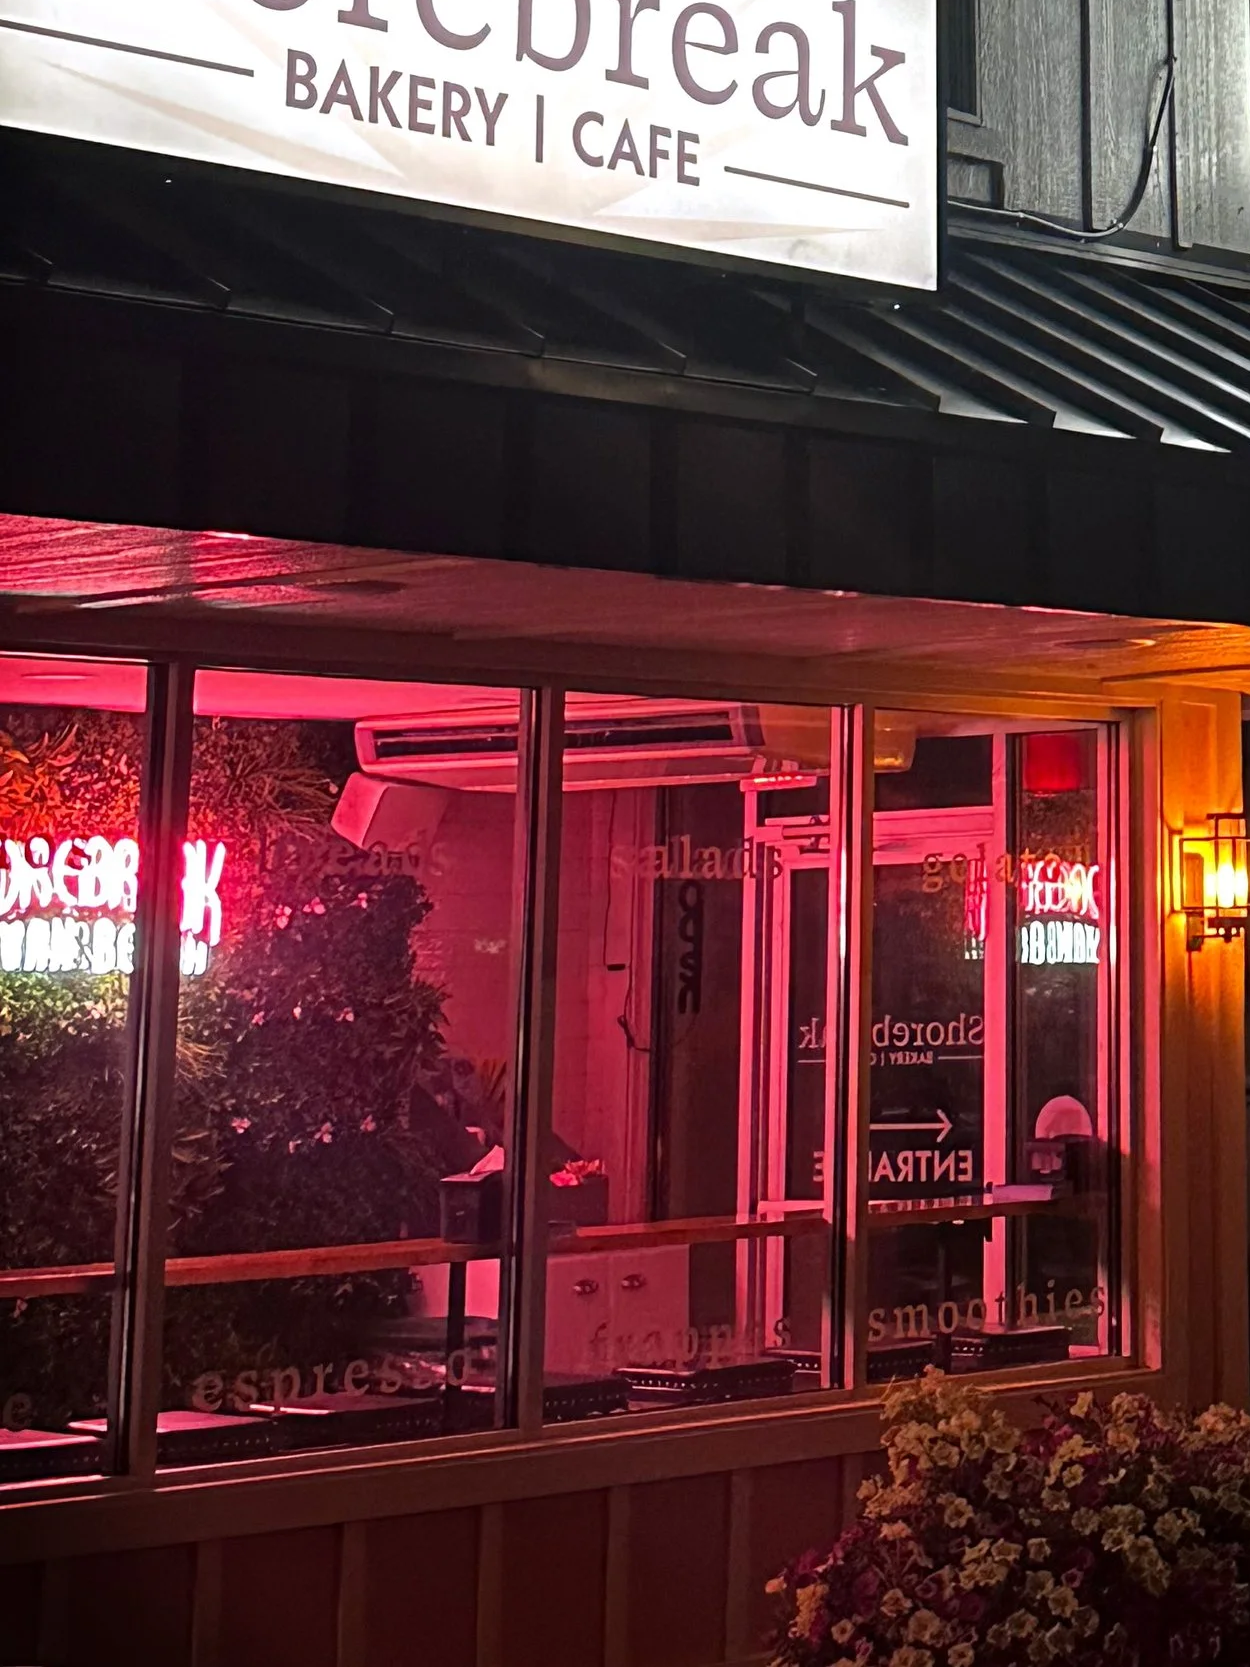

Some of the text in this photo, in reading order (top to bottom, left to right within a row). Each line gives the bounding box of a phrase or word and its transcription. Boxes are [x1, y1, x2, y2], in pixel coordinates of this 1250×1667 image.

[285, 48, 509, 147] BAKERY
[572, 110, 702, 187] CAFE
[867, 1278, 1108, 1343] smoothies
[192, 1344, 475, 1414] espresso
